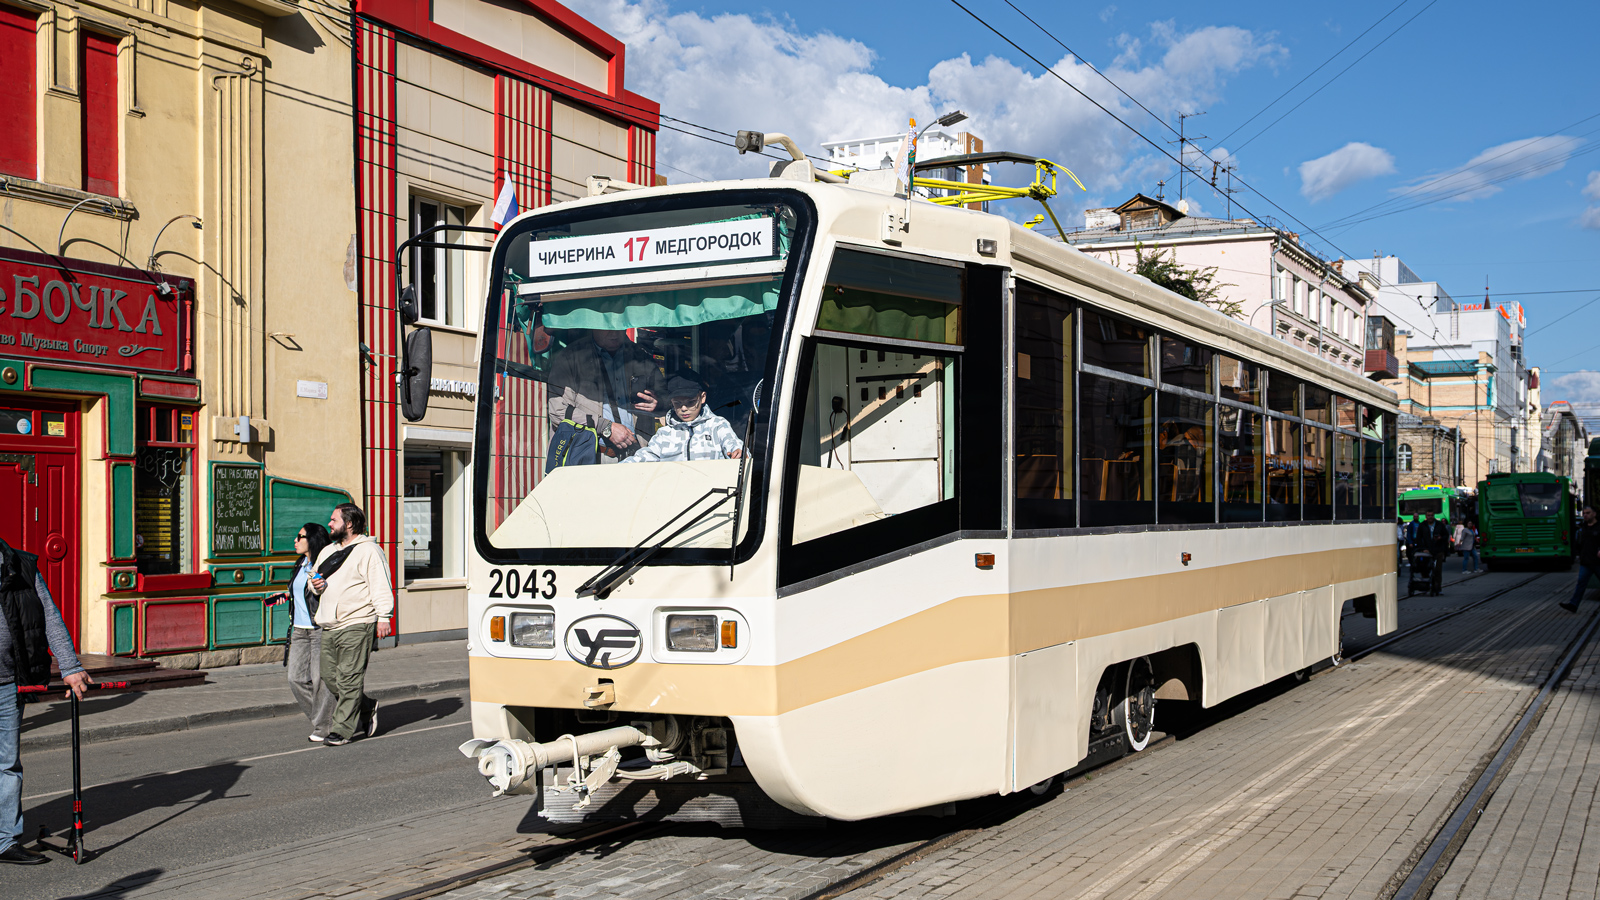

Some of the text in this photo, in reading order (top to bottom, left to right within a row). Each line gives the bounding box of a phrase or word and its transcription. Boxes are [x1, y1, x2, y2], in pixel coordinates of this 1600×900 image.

[538, 231, 762, 266] ЧИЧЕРИНА 17 МЕДГОРОДОК
[20, 332, 69, 351] Музыка
[73, 338, 109, 357] Спорт
[216, 468, 259, 479] МЫ РАБОТАЕМ
[488, 568, 557, 600] 2043
